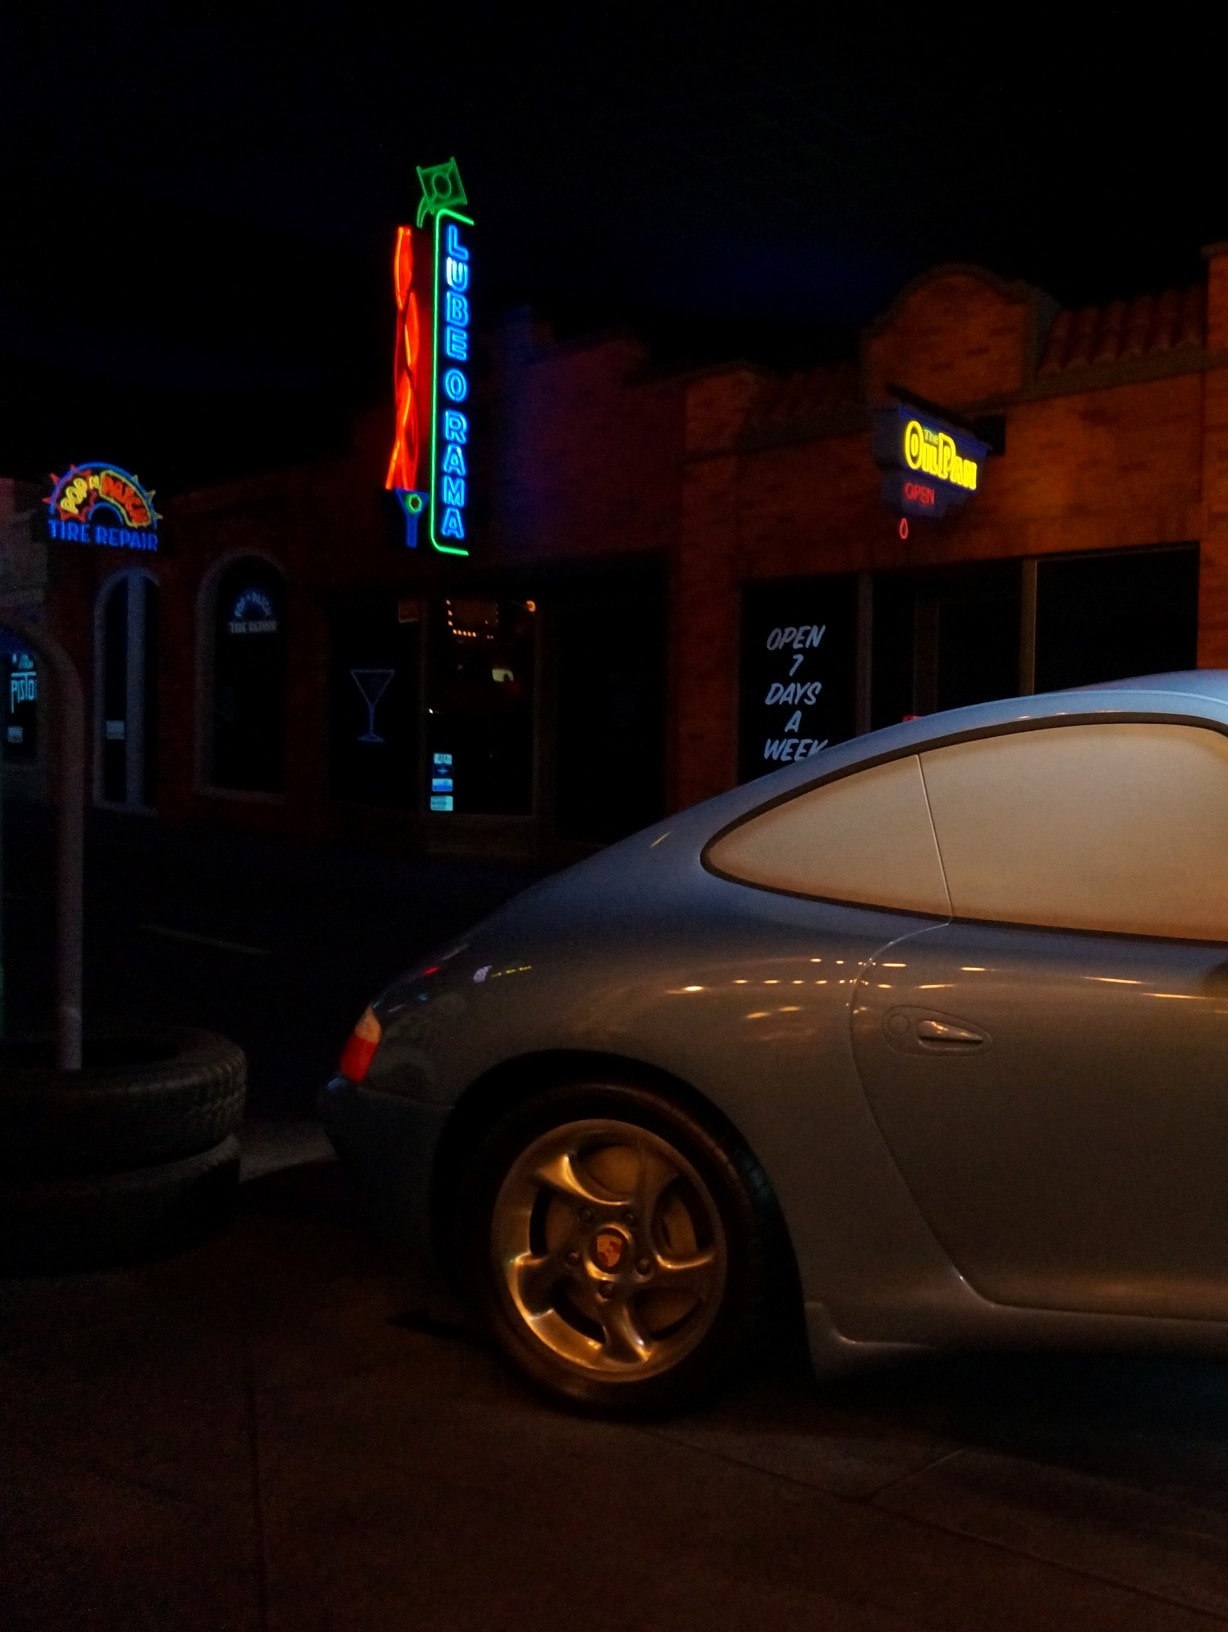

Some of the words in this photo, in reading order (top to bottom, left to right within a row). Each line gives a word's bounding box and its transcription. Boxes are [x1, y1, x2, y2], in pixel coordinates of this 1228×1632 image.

[60, 477, 88, 515] POP
[903, 482, 935, 505] OPEN
[48, 519, 91, 543] TIRE
[95, 526, 159, 552] REPAIR
[766, 624, 826, 651] OPEN
[788, 653, 804, 677] 7
[764, 681, 822, 706] DAYS
[784, 710, 802, 733] A
